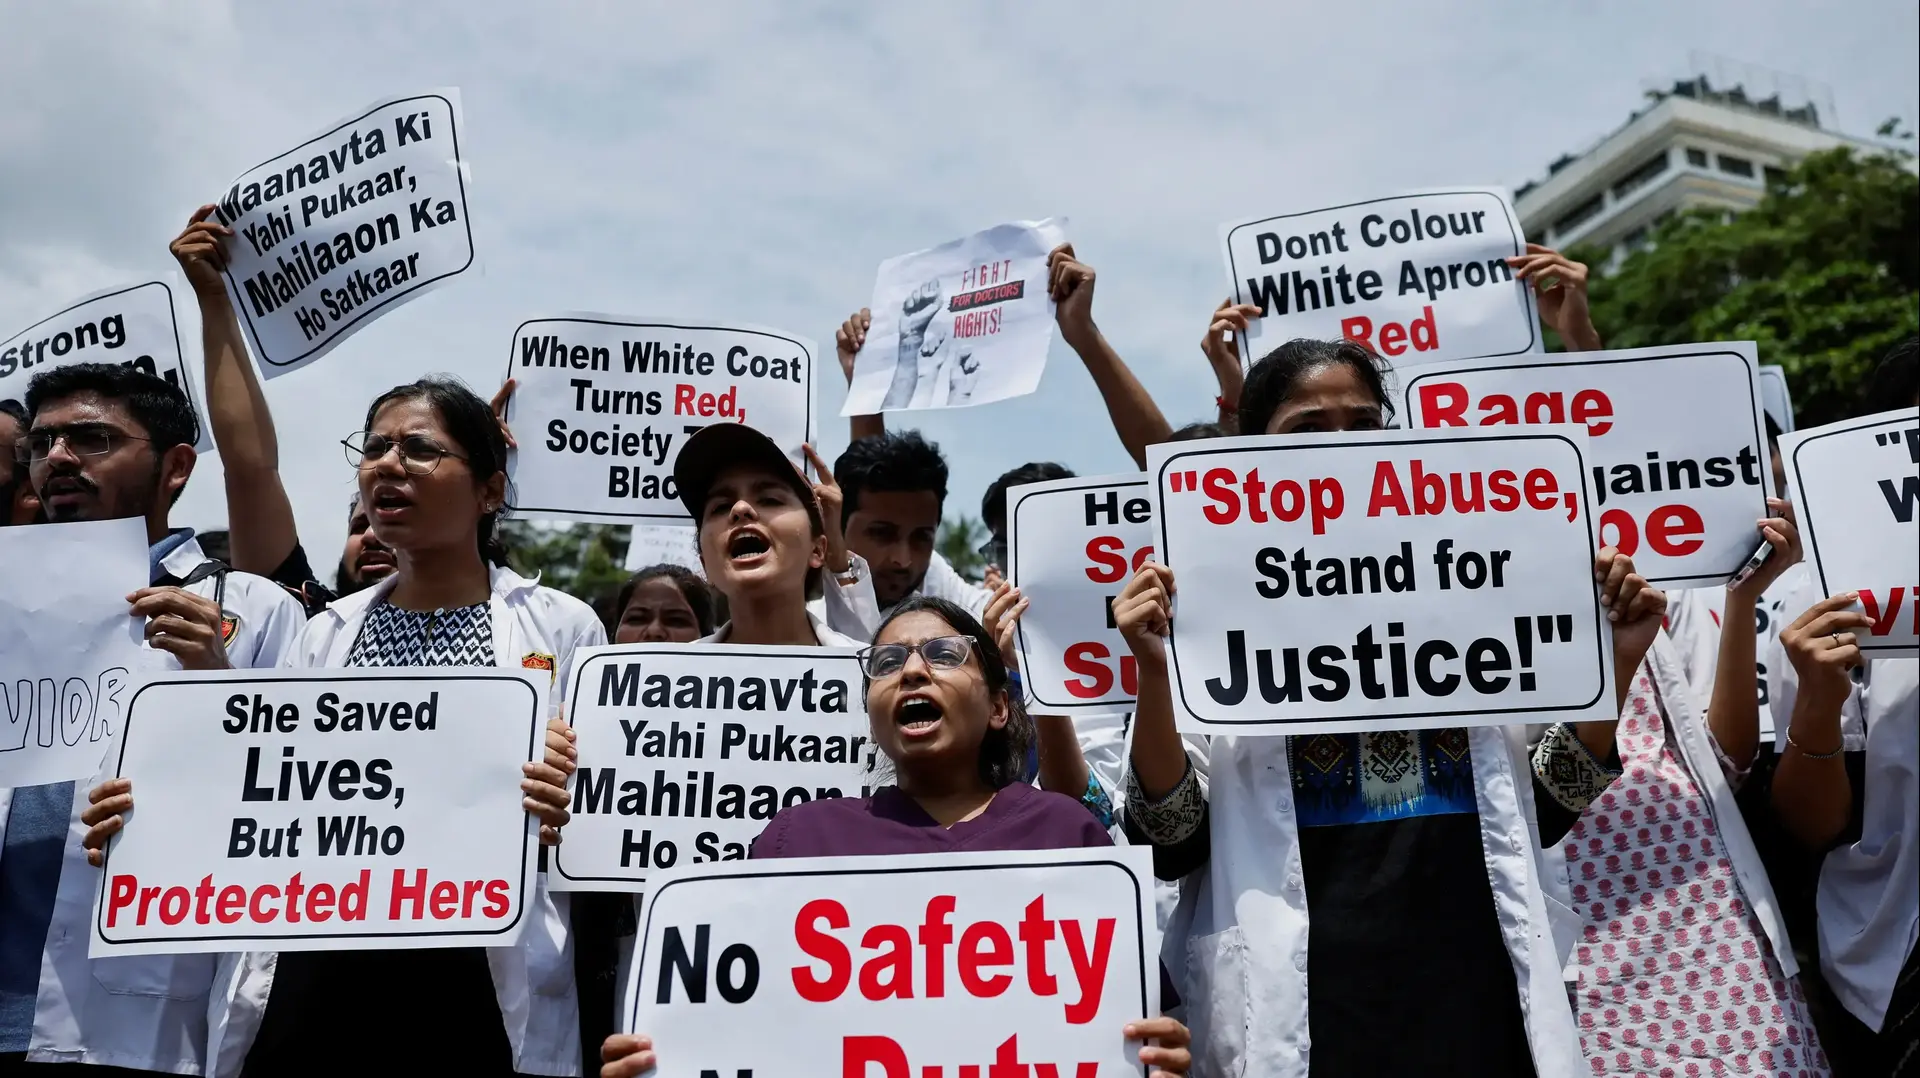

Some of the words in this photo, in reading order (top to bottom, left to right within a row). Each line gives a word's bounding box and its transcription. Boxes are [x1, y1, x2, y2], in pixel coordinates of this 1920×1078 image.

[216, 130, 387, 227] Maanavta
[396, 112, 431, 146] Ki
[242, 210, 294, 258] Yahi
[302, 164, 416, 227] Pukaar,
[1257, 219, 1348, 264] Dont
[1361, 209, 1484, 247] Colour
[243, 212, 401, 318] Mahilaaon
[411, 198, 456, 232] Ka
[962, 259, 1011, 291] FIGHT
[298, 301, 325, 341] Ho
[331, 250, 420, 321] Satkaar
[952, 294, 972, 308] FOR
[1247, 263, 1383, 318] White
[1398, 259, 1512, 300] Apron
[0, 313, 126, 378] Strong
[953, 306, 1002, 338] RIGHTS!
[1342, 306, 1438, 356] Red
[523, 336, 609, 371] When
[623, 341, 714, 375] White
[727, 344, 803, 383] Coat
[571, 379, 661, 415] Turns
[675, 384, 745, 424] Red,
[547, 420, 672, 467] Society
[1170, 468, 1344, 535] "Stop
[1368, 460, 1578, 522] Abuse,
[1256, 542, 1415, 599] Stand
[1434, 539, 1511, 589] for
[1205, 614, 1573, 707] Justice!"
[223, 694, 299, 733] She
[314, 692, 438, 732] Saved
[598, 664, 847, 713] Maanavta
[620, 720, 705, 758] Yahi
[721, 722, 875, 772] Pukaar,
[242, 747, 404, 809] Lives,
[228, 818, 302, 857] But
[318, 816, 404, 856] Who
[621, 829, 677, 869] Ho
[107, 869, 371, 928] Protected
[389, 868, 510, 920] Hers
[657, 925, 759, 1004] No
[791, 895, 1116, 1025] Safety
